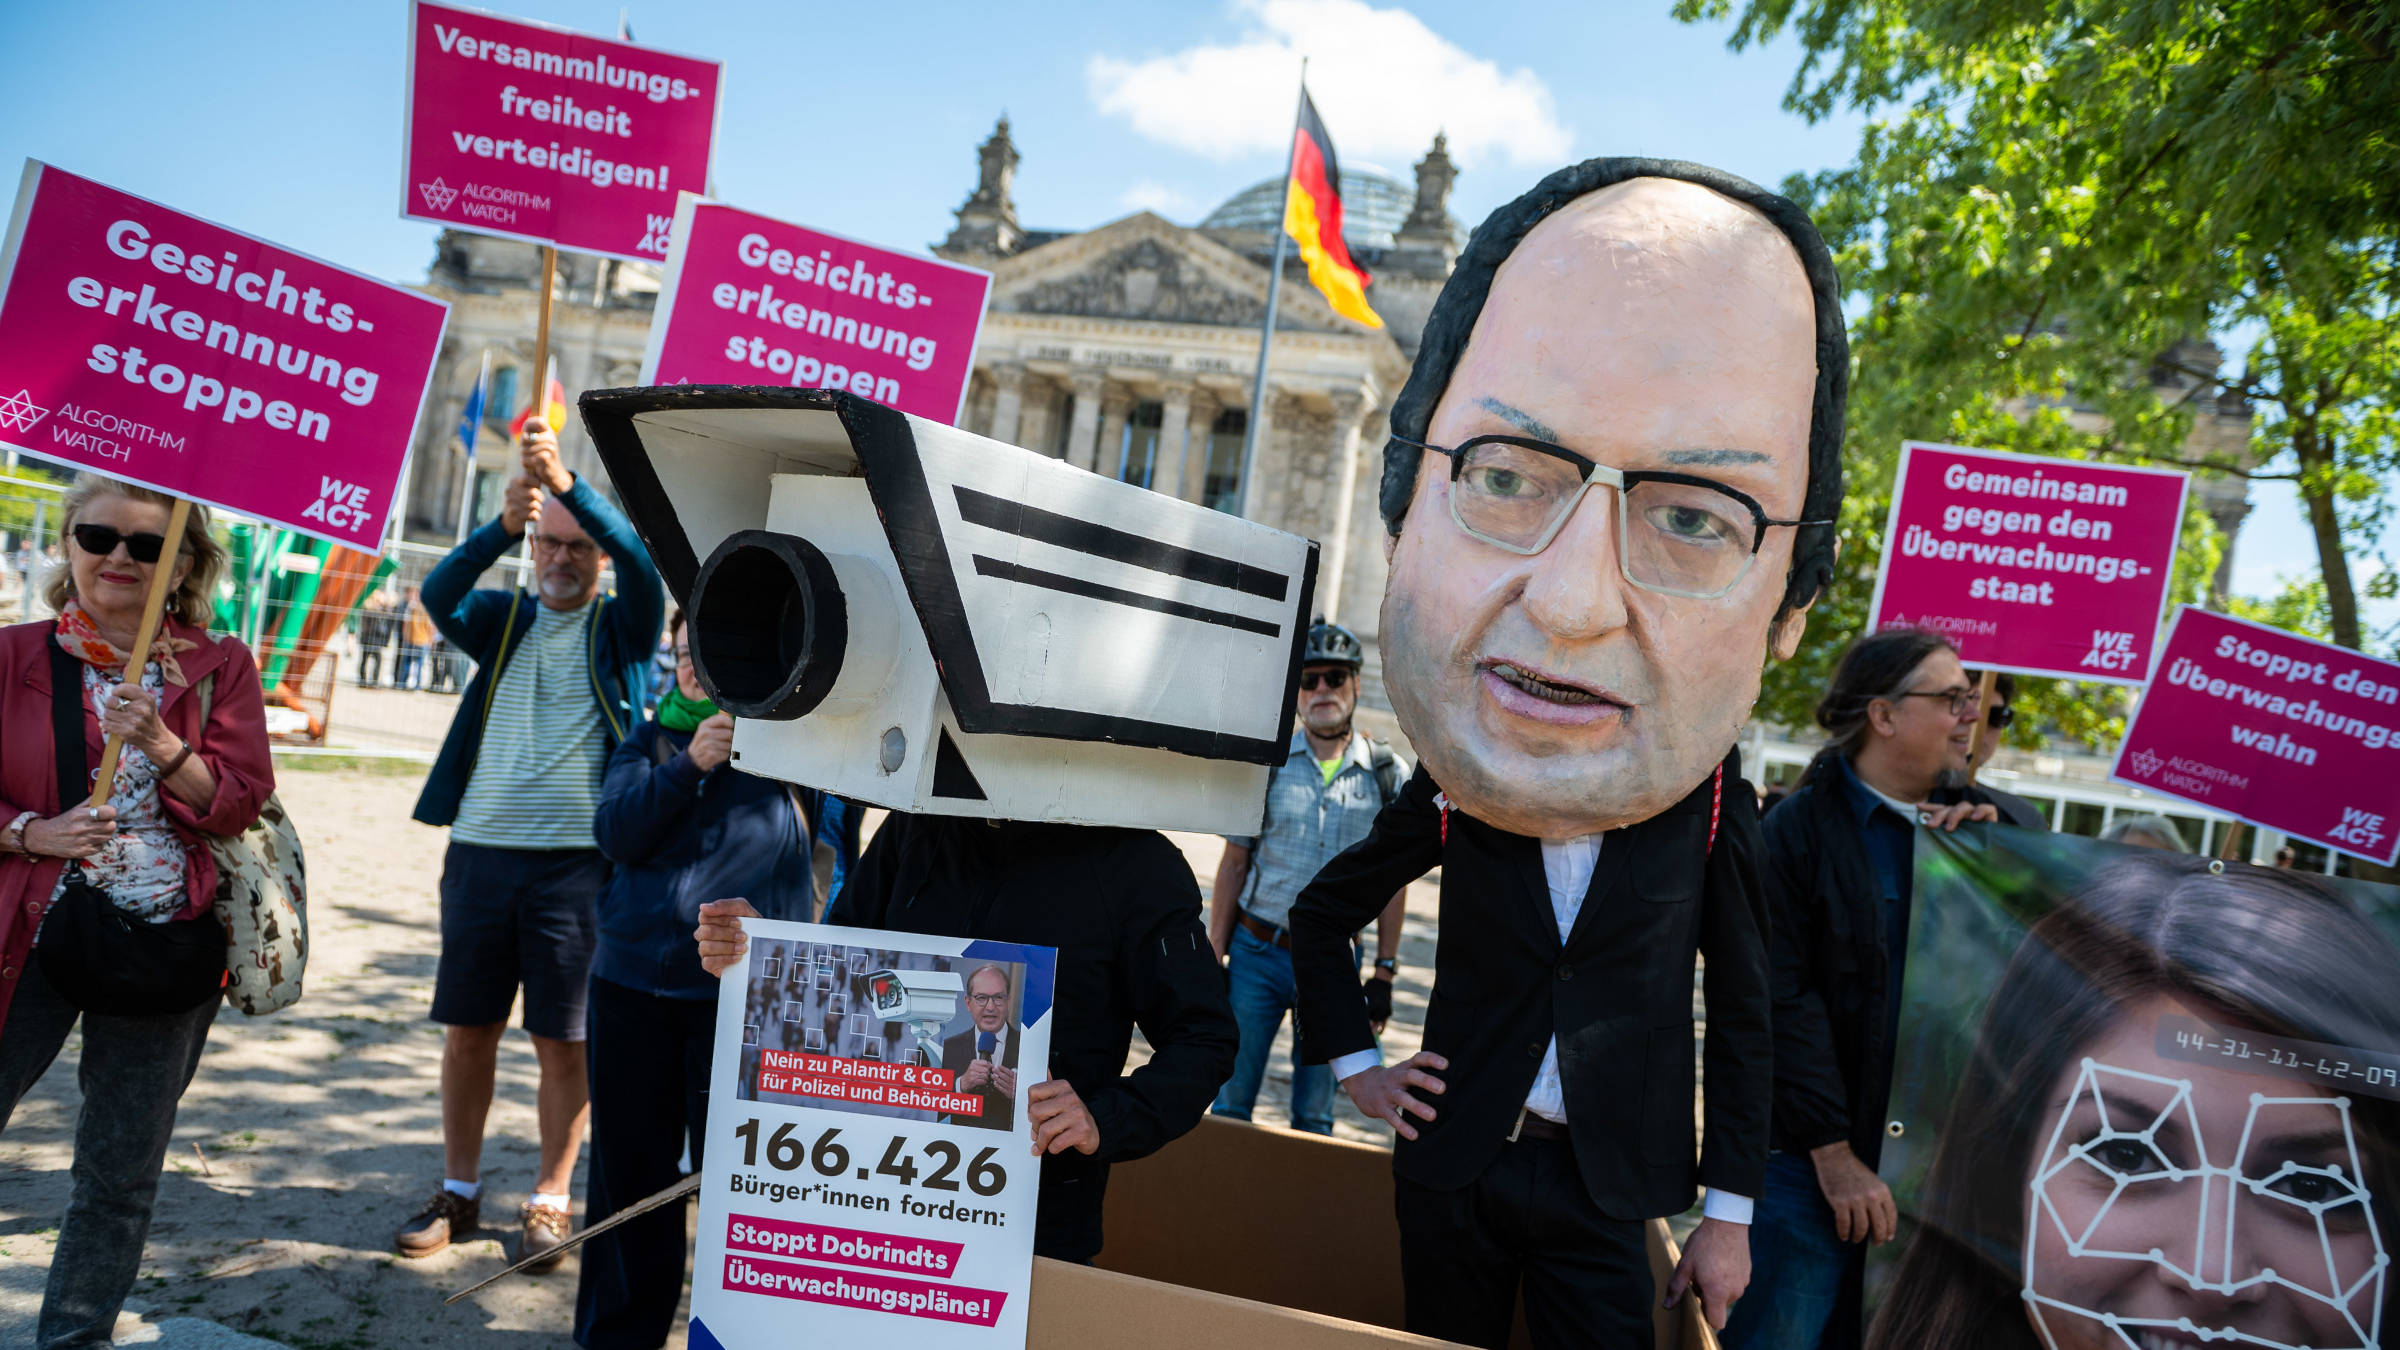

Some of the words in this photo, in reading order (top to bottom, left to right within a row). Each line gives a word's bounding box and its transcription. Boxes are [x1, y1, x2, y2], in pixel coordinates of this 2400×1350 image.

[433, 24, 700, 103] Versammlungs-
[500, 86, 632, 139] freiheit
[453, 130, 669, 192] verteidigen!
[461, 201, 516, 225] WATCH
[462, 182, 551, 211] ALGORITHM
[635, 232, 670, 254] AC
[646, 213, 673, 236] W
[106, 219, 375, 334] Gesichts-
[738, 232, 932, 310] Gesichts-
[67, 275, 379, 406] erkennung
[712, 282, 937, 372] erkennung
[726, 334, 901, 405] stoppen
[86, 342, 331, 442] stoppen
[52, 427, 131, 463] WATCH
[57, 403, 185, 453] ALGORITHM
[320, 475, 371, 510] WE
[1943, 464, 2128, 508] Gemeinsam
[302, 502, 372, 533] ACT
[1943, 504, 2042, 538] gegen
[2047, 509, 2112, 541] den
[1902, 525, 2152, 584] Überwachungs-
[1969, 577, 2054, 607] staat
[2081, 648, 2137, 672] ACT
[2092, 629, 2135, 653] WE
[2215, 635, 2328, 687] Stoppt
[2332, 669, 2399, 705] den
[2231, 724, 2318, 767] wahn
[2163, 772, 2212, 797] WATCH
[2167, 756, 2249, 790] ALGORITHM
[2326, 824, 2386, 850] ACT
[2341, 807, 2385, 833] WE
[764, 1051, 805, 1069] Nein
[808, 1061, 827, 1073] zu
[832, 1059, 900, 1081] Palantir
[903, 1068, 917, 1083] &
[921, 1070, 947, 1086] Co.
[2176, 1030, 2400, 1087] 44-31-11-62-09
[762, 1072, 788, 1088] für
[791, 1076, 846, 1097] Polizei
[850, 1086, 883, 1102] und
[888, 1088, 978, 1113] Behörden!
[735, 1118, 1008, 1197] 166.426
[900, 1194, 1006, 1227] fordern:
[730, 1222, 816, 1255] Stoppt
[821, 1234, 949, 1270] Dobrindts
[728, 1259, 991, 1319] Überwachungspläne!
